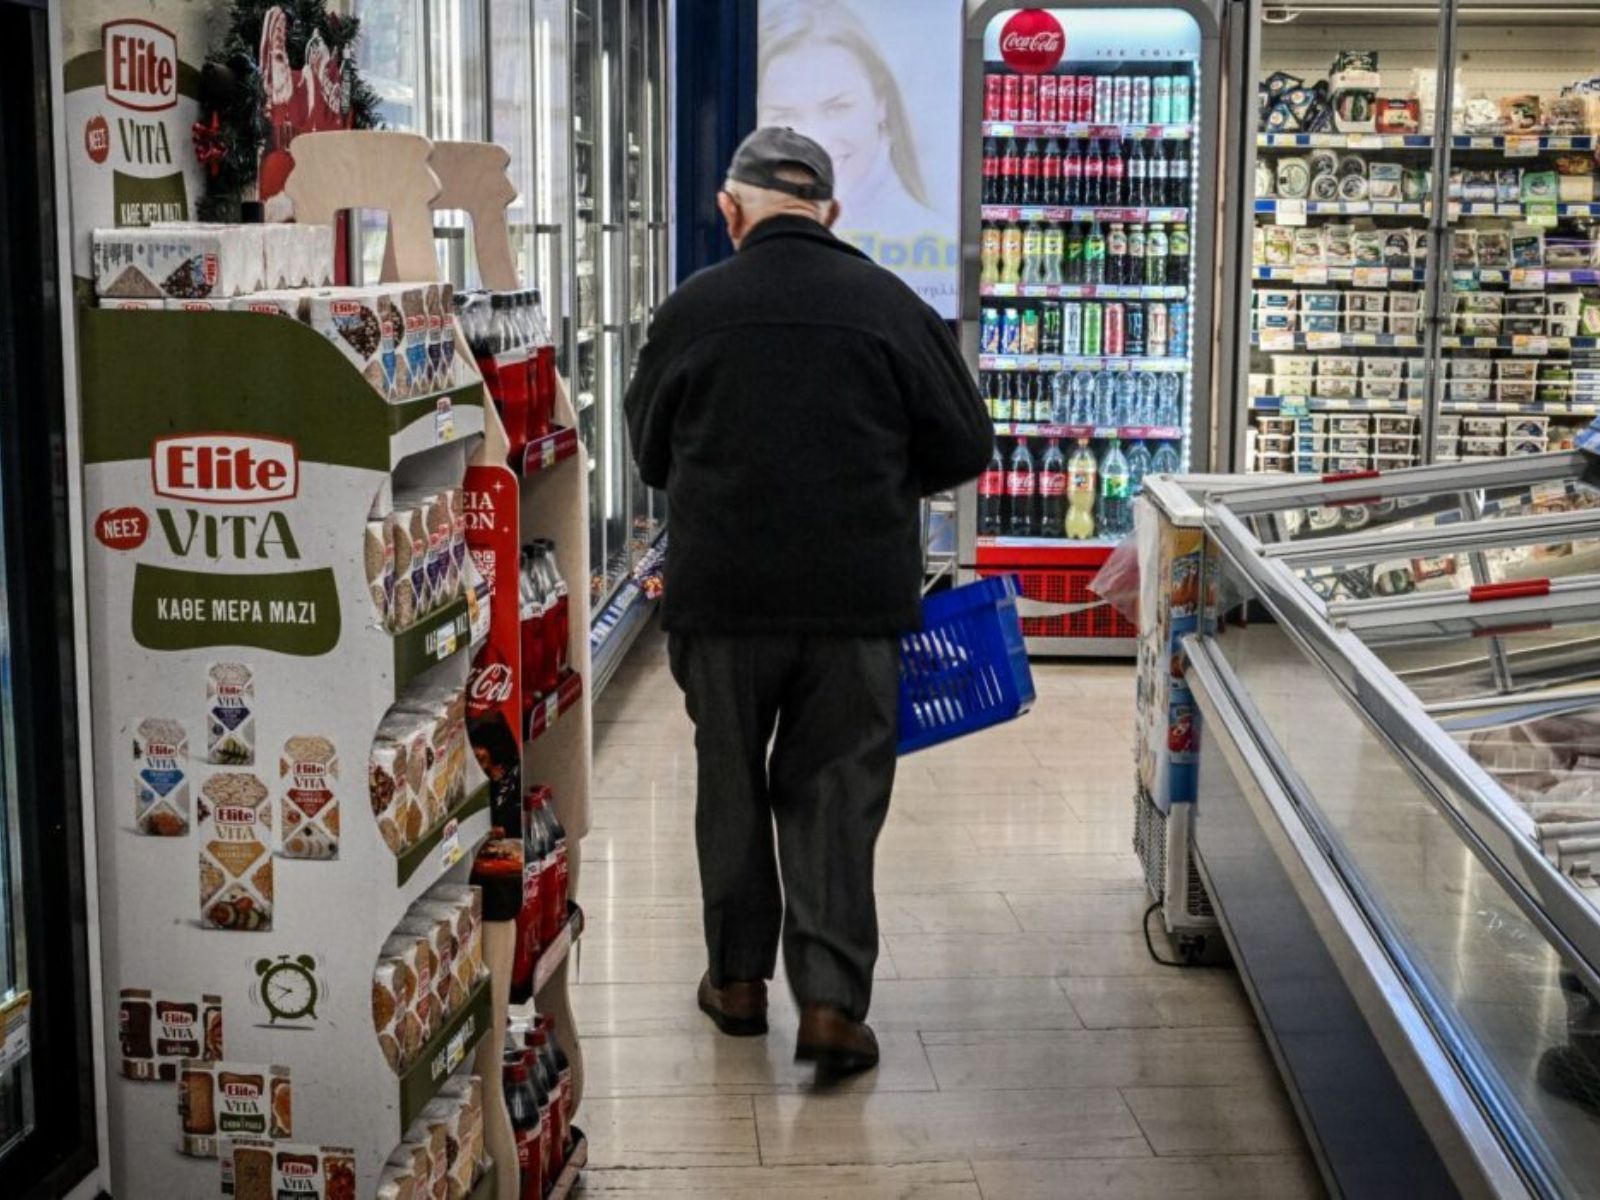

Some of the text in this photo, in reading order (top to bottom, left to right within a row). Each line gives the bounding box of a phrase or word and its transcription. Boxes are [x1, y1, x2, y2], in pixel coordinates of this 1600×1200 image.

[112, 34, 172, 96] Elite
[118, 118, 171, 164] VITA
[167, 446, 286, 490] Elite
[103, 517, 142, 539] ΝΕΕΣ
[156, 509, 300, 559] VITA
[157, 598, 315, 624] ΚΑΘΕ ΜΕΡΑ ΜΑΖΙ
[218, 807, 253, 822] Elite
[162, 1027, 194, 1039] VITA
[228, 1084, 256, 1097] Elite
[225, 1100, 259, 1113] VITA
[282, 1177, 313, 1190] VITA
